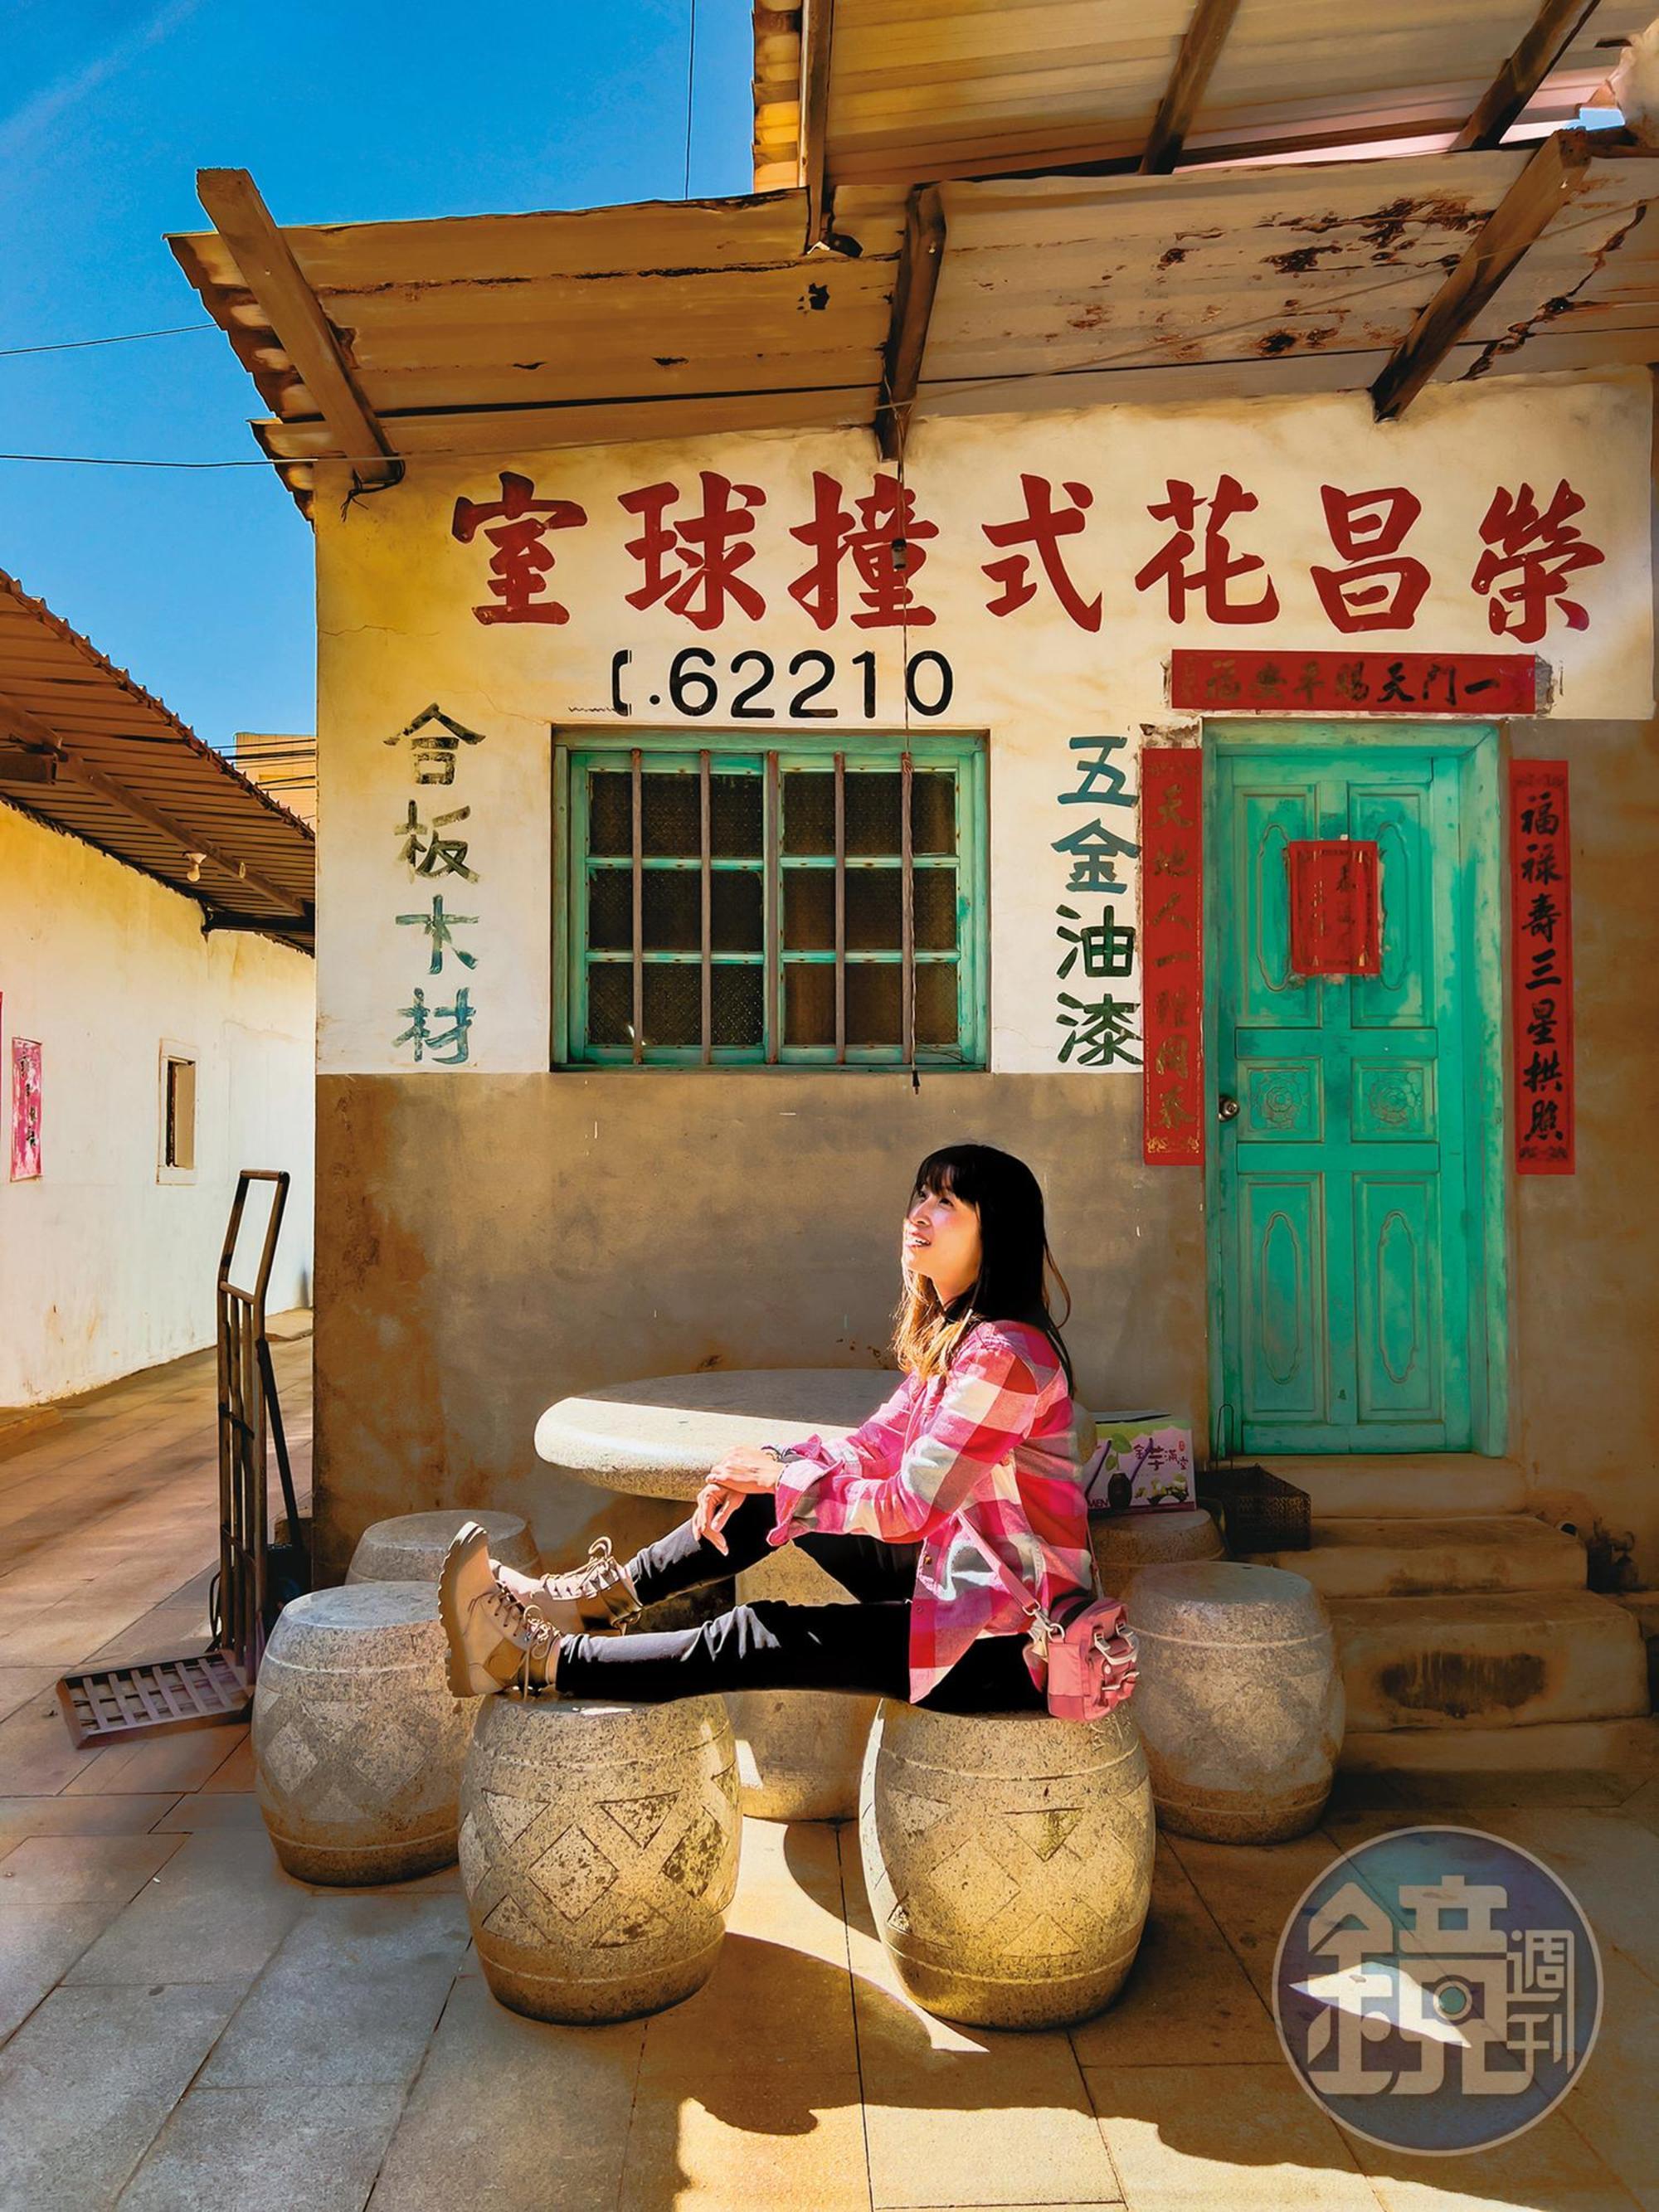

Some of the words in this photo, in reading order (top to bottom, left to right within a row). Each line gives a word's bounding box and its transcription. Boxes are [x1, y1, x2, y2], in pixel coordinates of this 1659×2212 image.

[452, 470, 1605, 644] 榮昌花式撞球室
[382, 702, 486, 1064] 合板木材
[1050, 736, 1144, 1067] 五金油漆
[1520, 790, 1563, 1141] 福祿壽三星拱照
